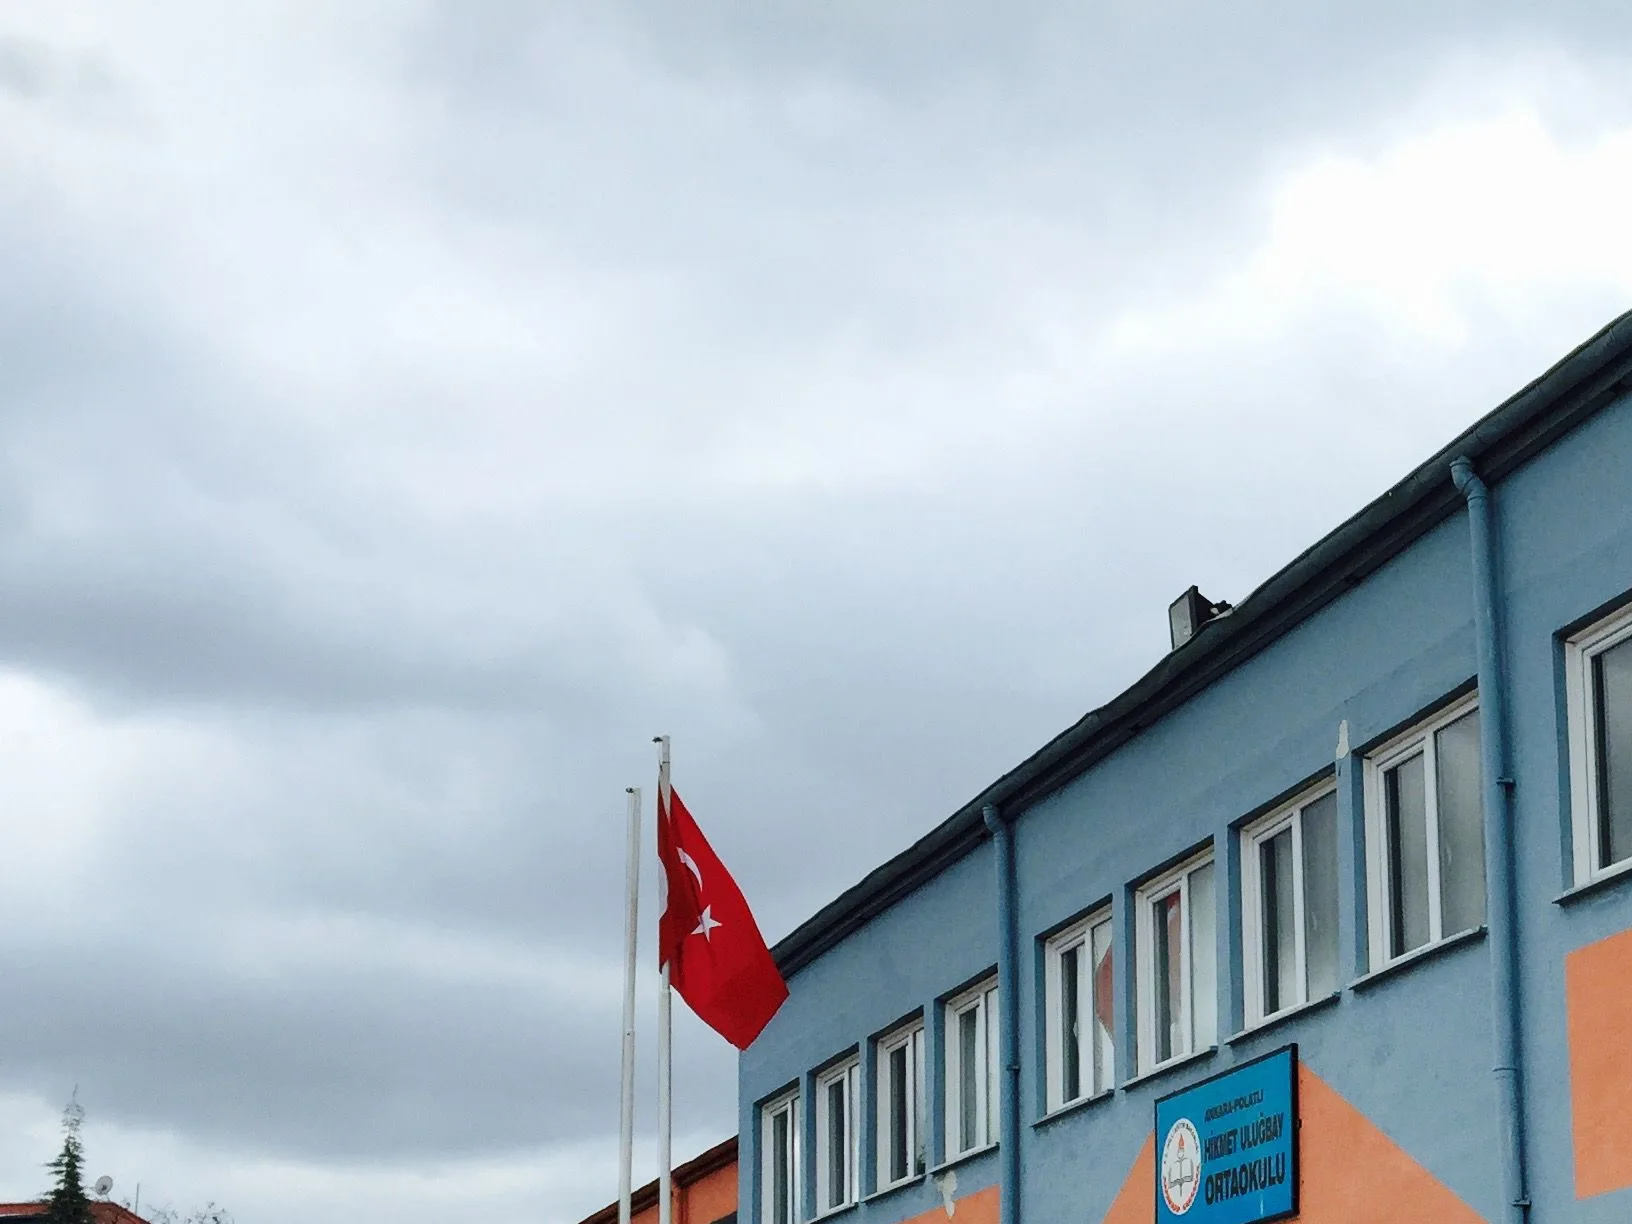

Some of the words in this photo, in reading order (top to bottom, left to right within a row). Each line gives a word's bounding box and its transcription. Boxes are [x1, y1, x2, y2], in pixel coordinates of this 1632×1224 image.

[1204, 1129, 1238, 1162] HİKMET
[1240, 1112, 1284, 1151] ULUĞBAY
[1206, 1152, 1285, 1205] ORTAOKULU
